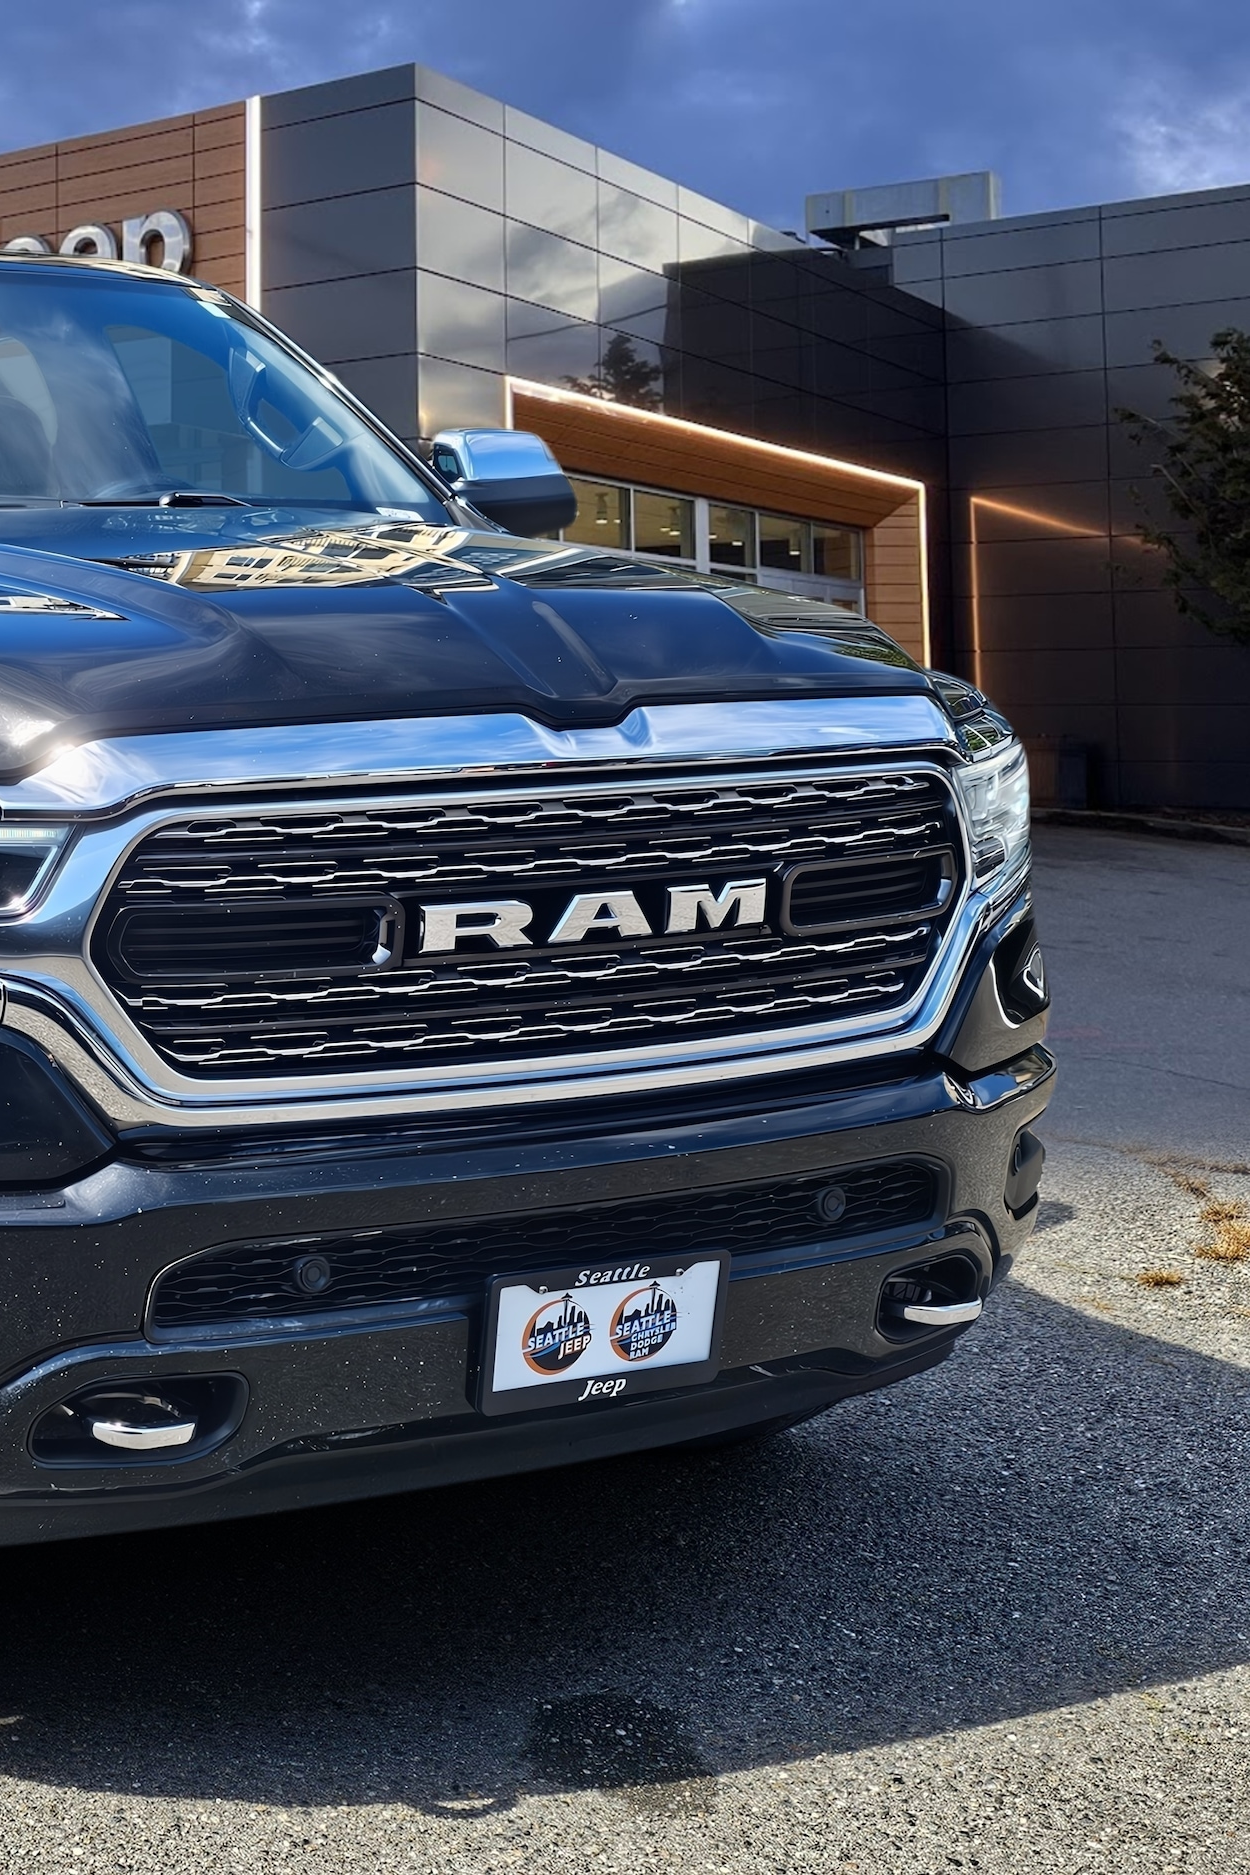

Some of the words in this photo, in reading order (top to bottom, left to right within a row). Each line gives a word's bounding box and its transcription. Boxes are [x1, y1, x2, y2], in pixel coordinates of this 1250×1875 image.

[419, 878, 766, 953] RAM
[575, 1264, 650, 1287] Seattle
[615, 1310, 671, 1337] SEATTLE
[631, 1321, 676, 1342] CHRYSLER
[527, 1322, 585, 1350] SEATTLE
[558, 1335, 591, 1360] JEEP
[630, 1334, 664, 1351] DODGE
[629, 1347, 649, 1360] RAM
[578, 1378, 627, 1401] Jeep
